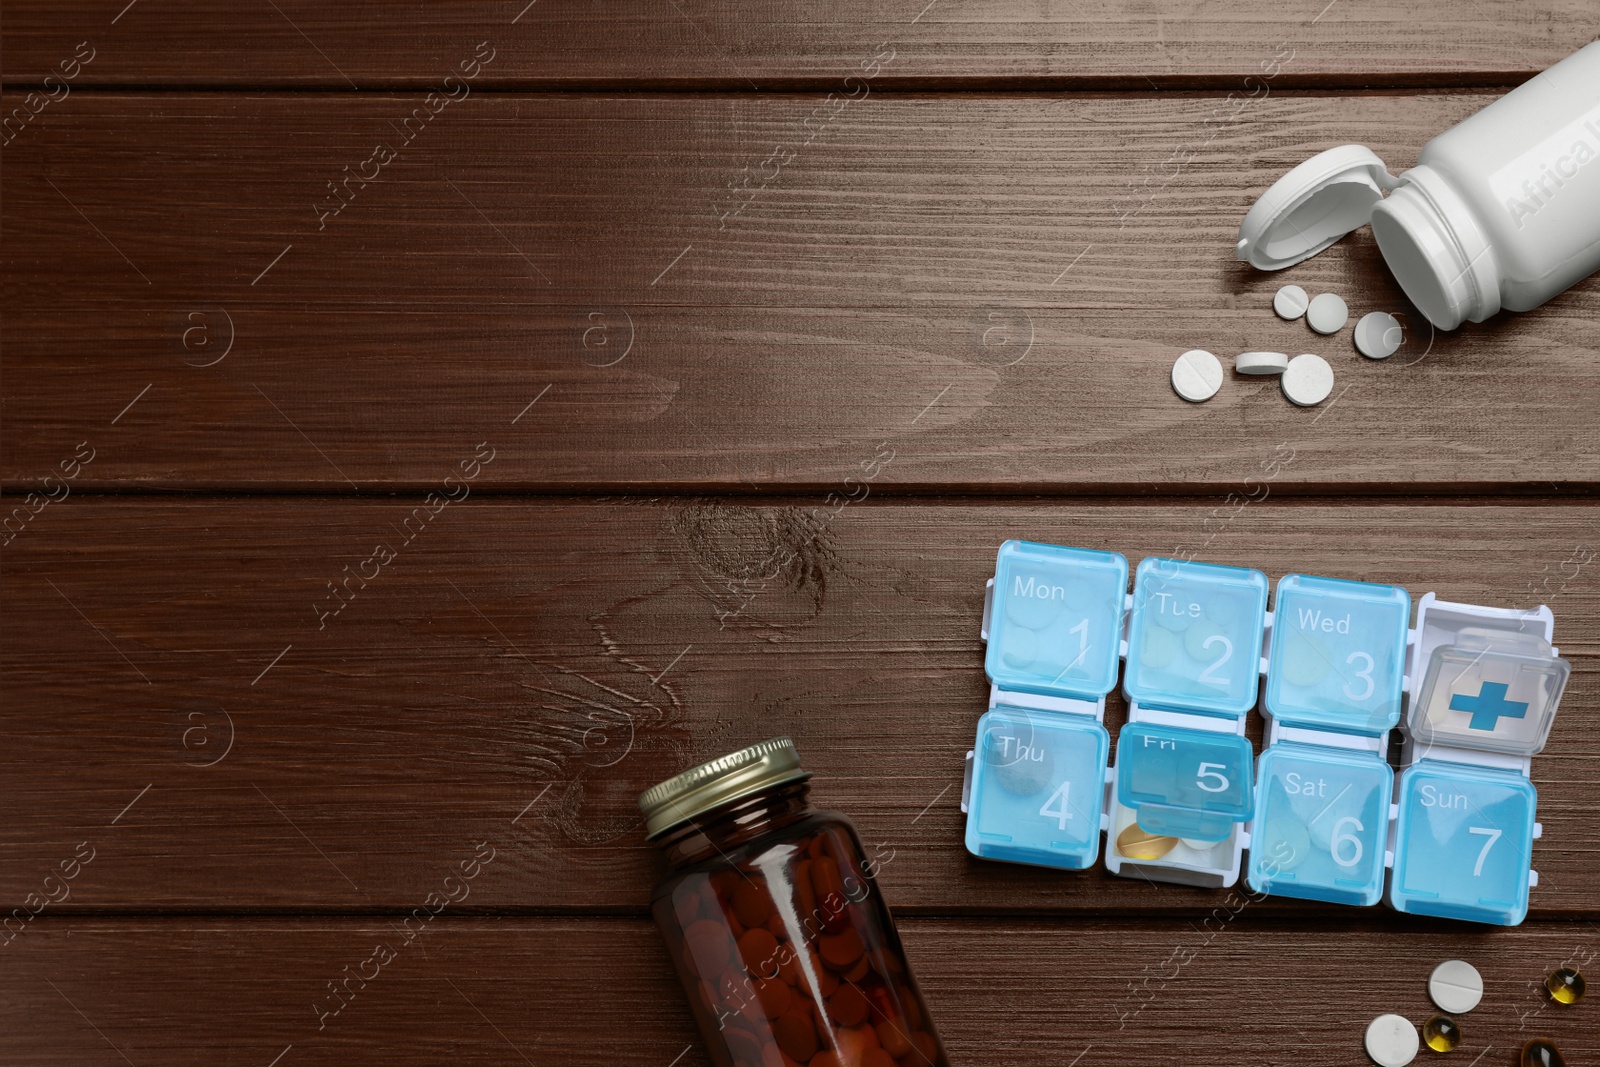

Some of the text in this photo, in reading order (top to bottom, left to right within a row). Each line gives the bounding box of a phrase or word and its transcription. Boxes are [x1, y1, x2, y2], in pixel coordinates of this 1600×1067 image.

[1013, 575, 1065, 600] Mon
[1155, 592, 1201, 618] Tue
[1298, 608, 1351, 635] Wed
[1068, 618, 1089, 667] 1
[1198, 635, 1234, 685] 2
[1341, 651, 1375, 701] 3
[998, 735, 1045, 762] Thu
[1143, 735, 1176, 751] Fri
[1195, 761, 1230, 793] 5
[1284, 772, 1327, 798] Sat
[1039, 780, 1073, 831] 4
[1419, 785, 1468, 810] Sun
[1330, 816, 1365, 867] 6
[1468, 826, 1503, 877] 7
